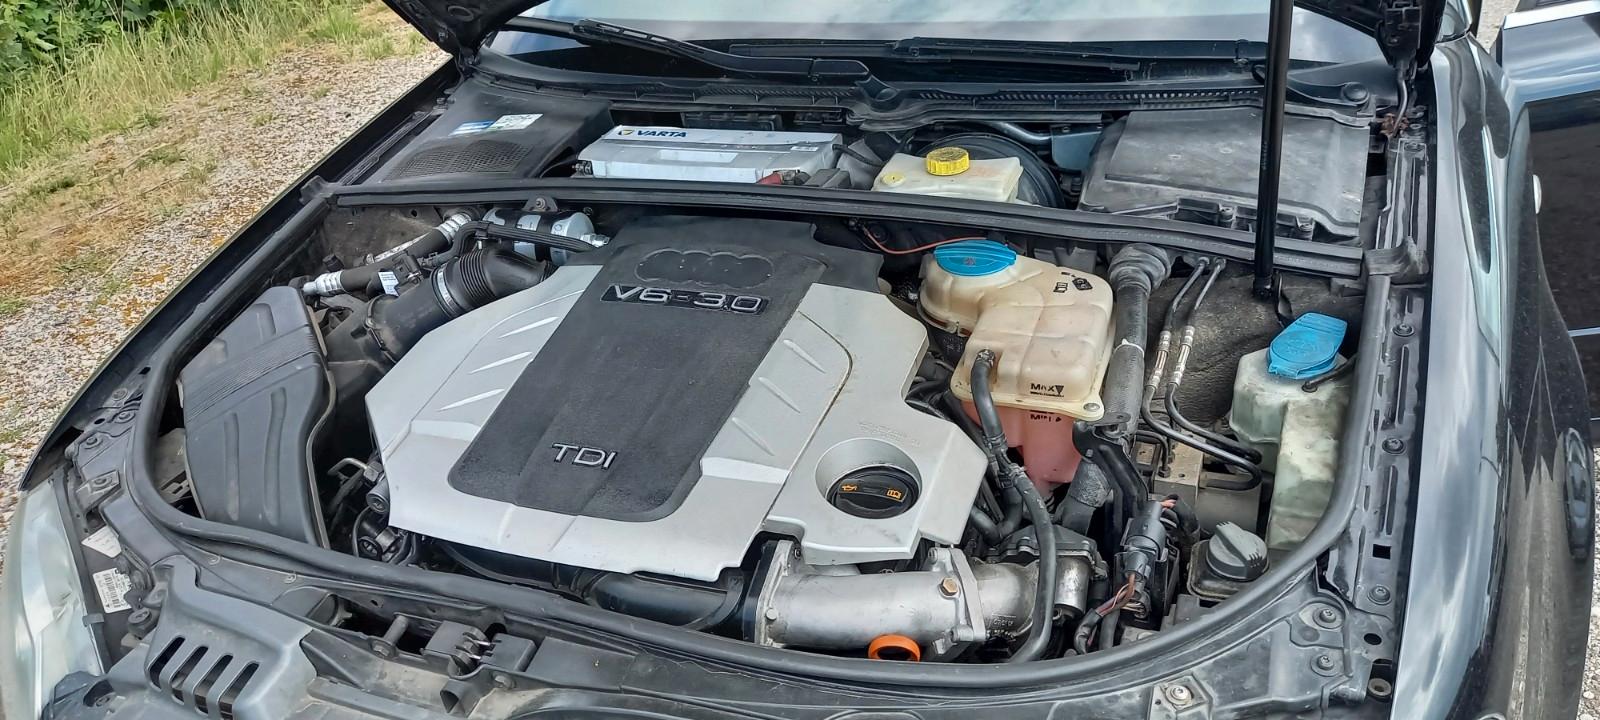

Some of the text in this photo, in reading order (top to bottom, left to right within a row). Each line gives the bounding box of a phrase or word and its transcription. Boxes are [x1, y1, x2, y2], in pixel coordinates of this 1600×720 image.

[636, 129, 687, 138] VARTA
[1030, 383, 1055, 392] MAX
[552, 443, 618, 470] TDI
